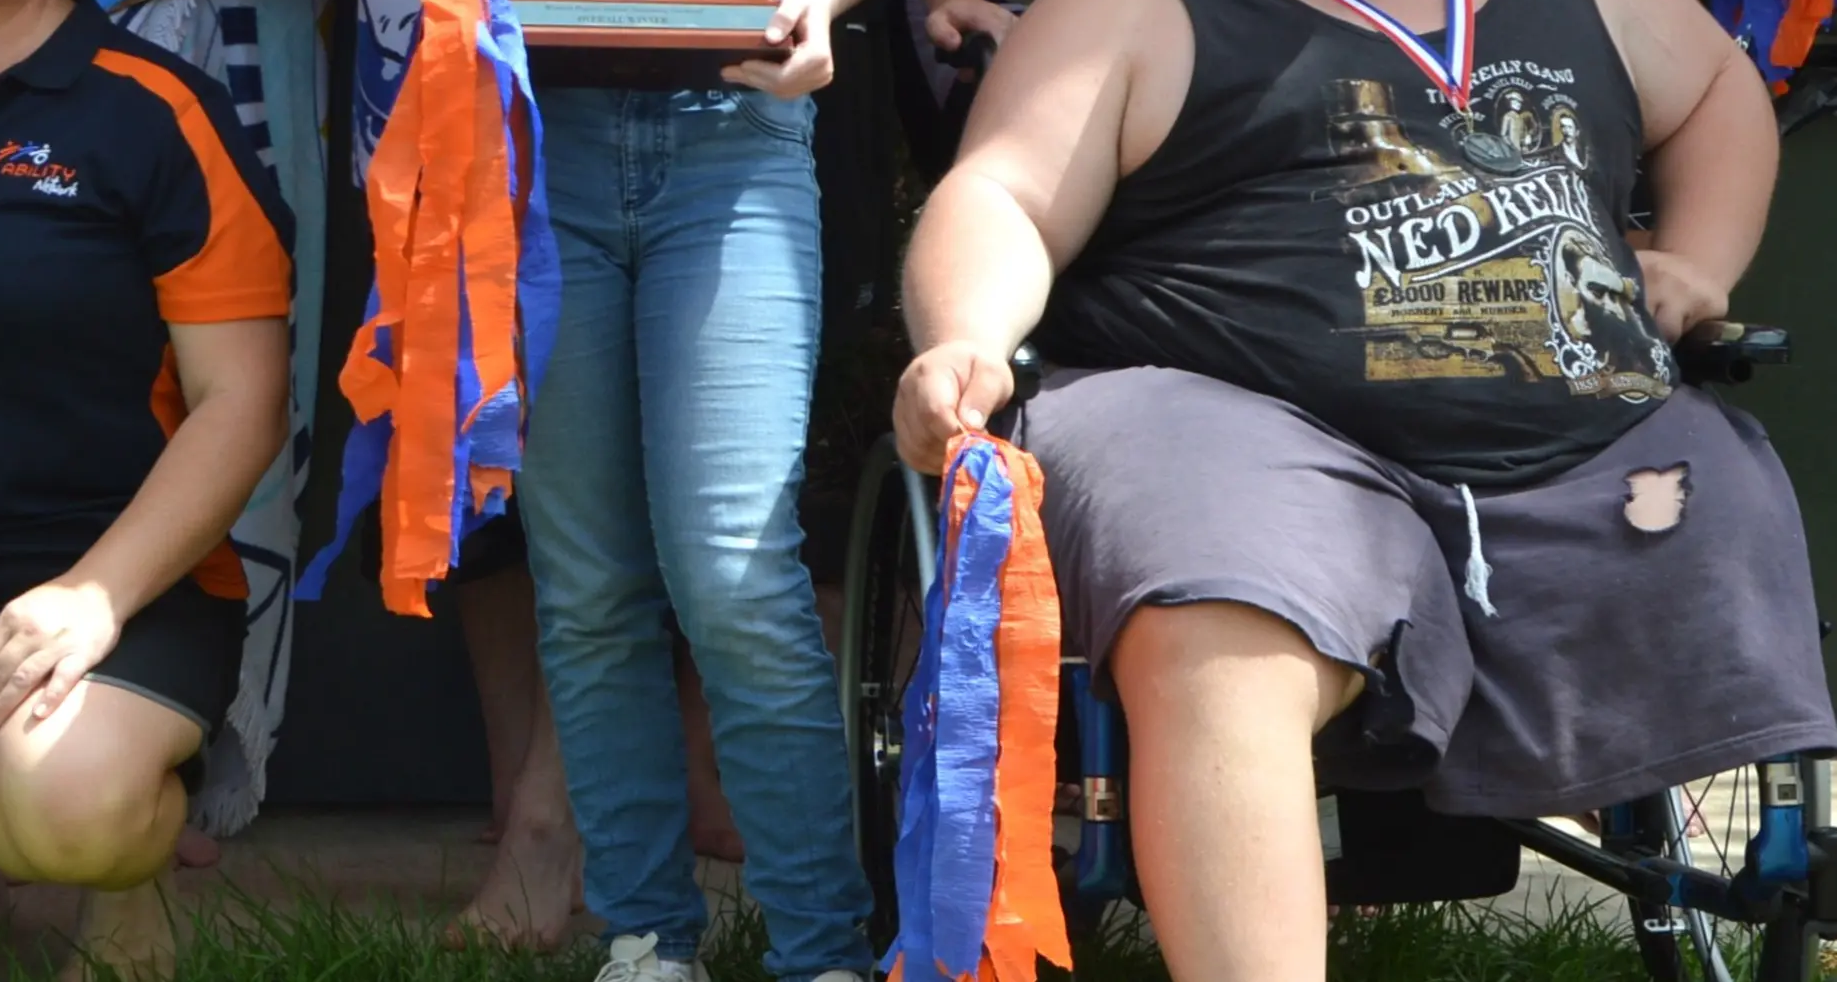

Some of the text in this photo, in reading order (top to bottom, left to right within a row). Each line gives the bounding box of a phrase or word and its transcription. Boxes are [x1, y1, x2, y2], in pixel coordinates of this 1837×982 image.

[1525, 61, 1575, 84] GANG
[0, 162, 77, 182] ABILITY
[32, 175, 79, 197] Network
[1345, 176, 1478, 225] OUTLAW
[1349, 171, 1595, 290] NED KELLY
[1374, 281, 1445, 306] £8000
